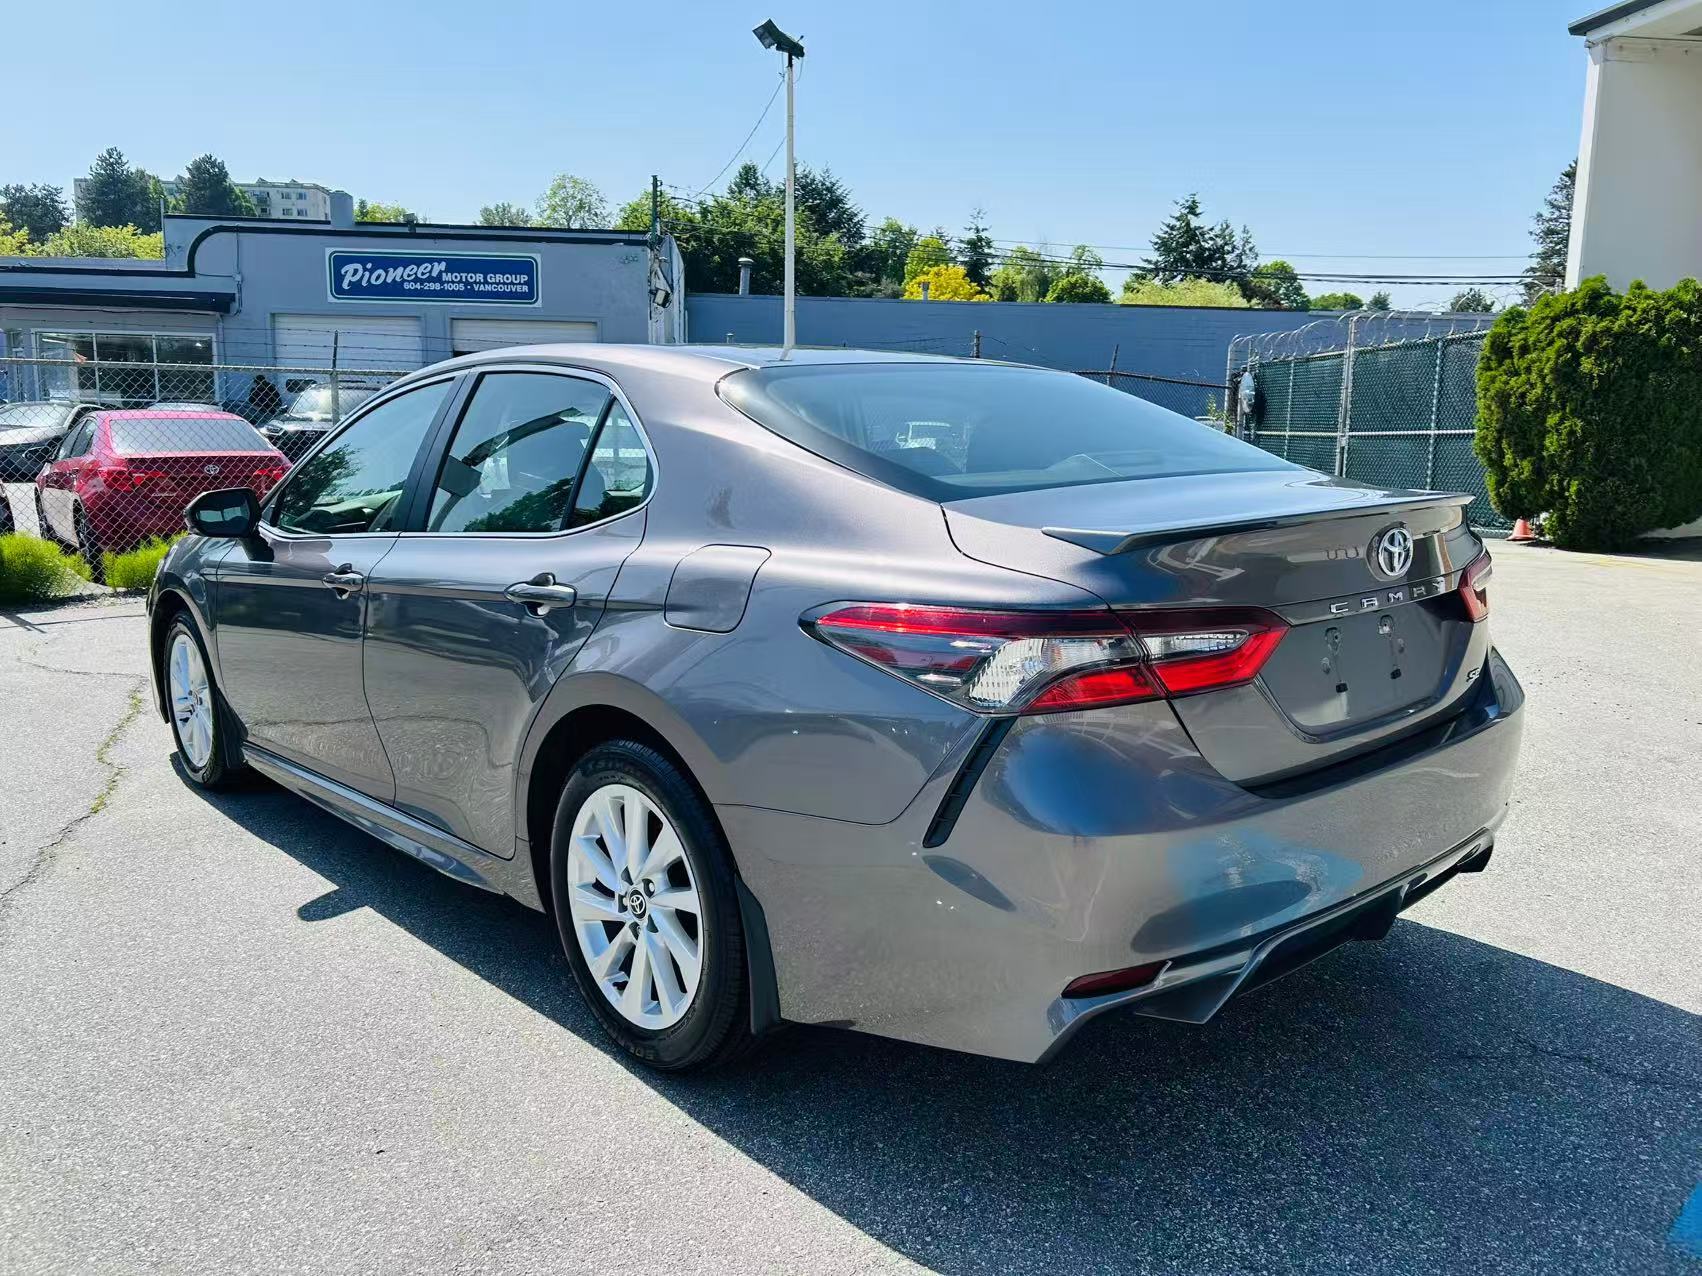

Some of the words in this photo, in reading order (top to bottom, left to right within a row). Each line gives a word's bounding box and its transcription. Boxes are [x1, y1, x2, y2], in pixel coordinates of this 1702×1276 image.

[340, 261, 447, 290] Pioneer
[442, 272, 484, 283] MOTOR
[487, 273, 529, 284] GROUP
[403, 281, 465, 291] 604-298-1005
[473, 283, 529, 293] VANCOUVER
[1328, 576, 1446, 614] CAMRY
